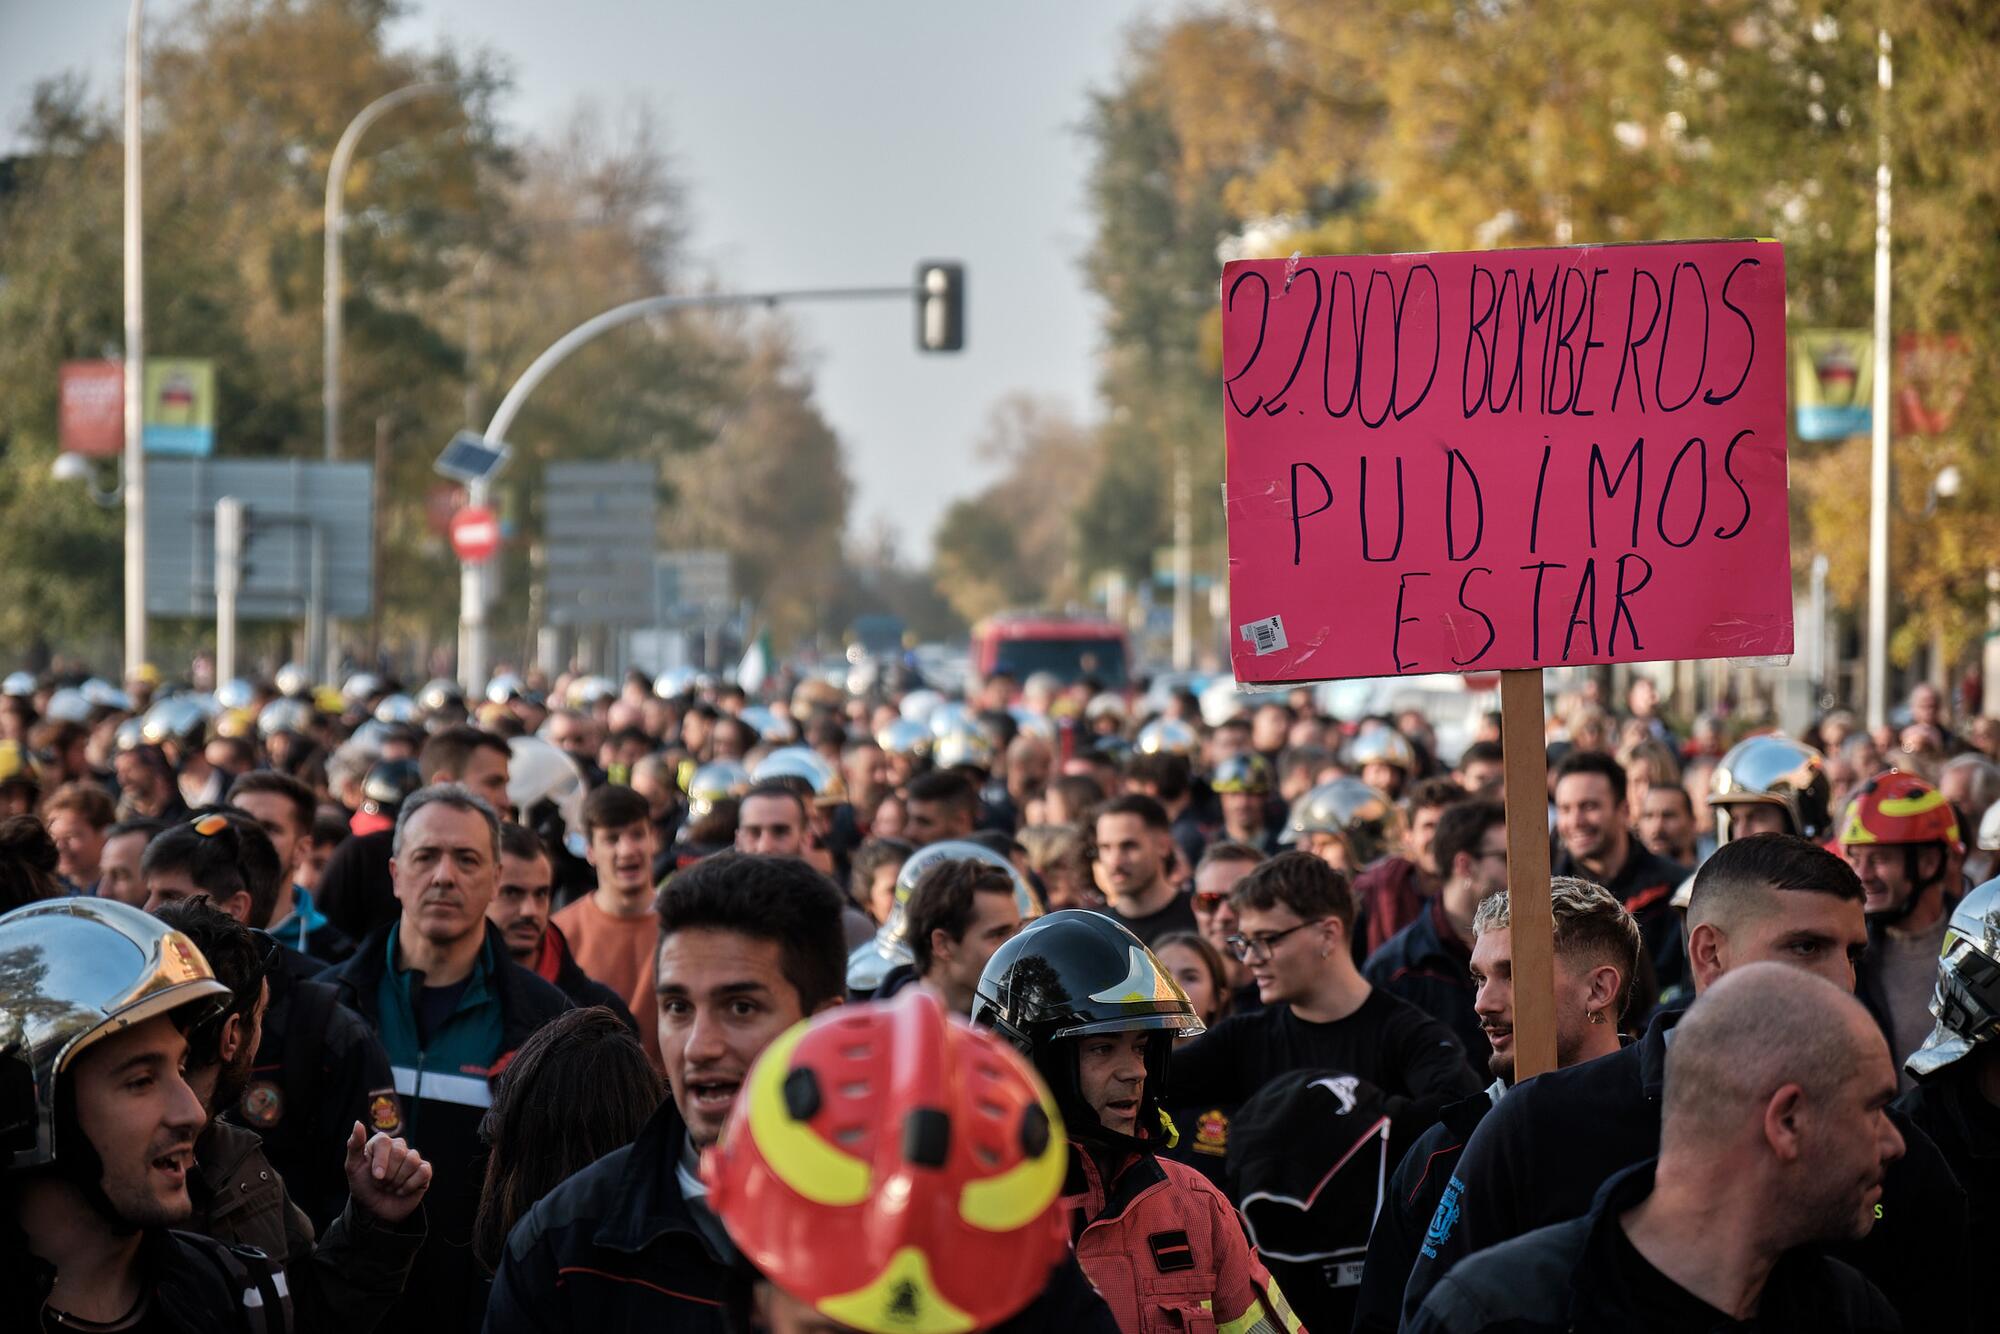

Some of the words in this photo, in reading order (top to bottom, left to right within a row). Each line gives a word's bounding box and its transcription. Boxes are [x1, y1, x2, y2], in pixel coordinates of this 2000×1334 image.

[1224, 266, 1441, 429] 22.000
[1462, 257, 1762, 420] BOMBEROS
[1290, 429, 1756, 566] PUDIMOS
[1392, 553, 1654, 674] ESTAR
[1448, 1175, 1465, 1194] EROS
[1421, 1244, 1437, 1259] DRID
